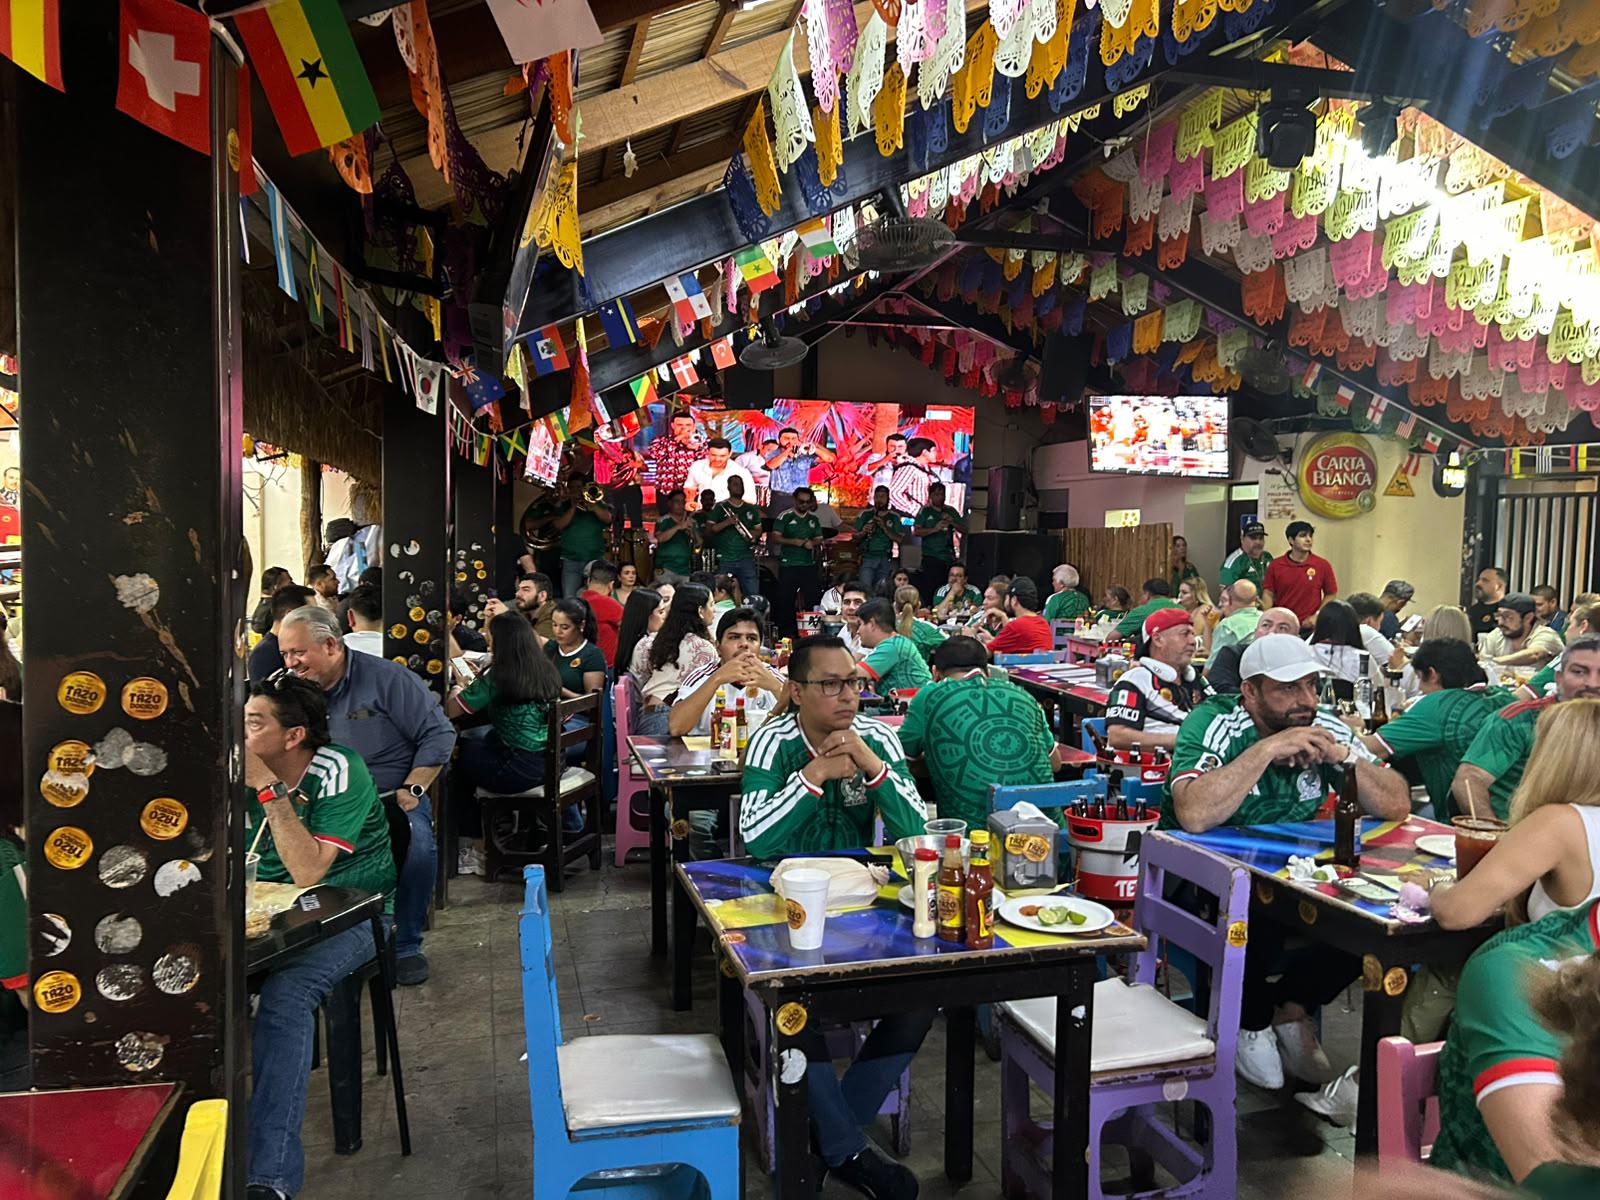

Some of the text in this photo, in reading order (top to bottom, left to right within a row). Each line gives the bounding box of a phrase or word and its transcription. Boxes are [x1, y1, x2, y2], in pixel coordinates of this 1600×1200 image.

[1317, 455, 1366, 472] CARTA
[1312, 471, 1372, 487] BLANCA
[66, 686, 98, 701] TAZO
[129, 693, 162, 704] TAZO
[150, 810, 179, 827] TAZO
[53, 838, 83, 859] TAZO
[1115, 880, 1138, 897] TE
[42, 984, 74, 1000] TAZO
